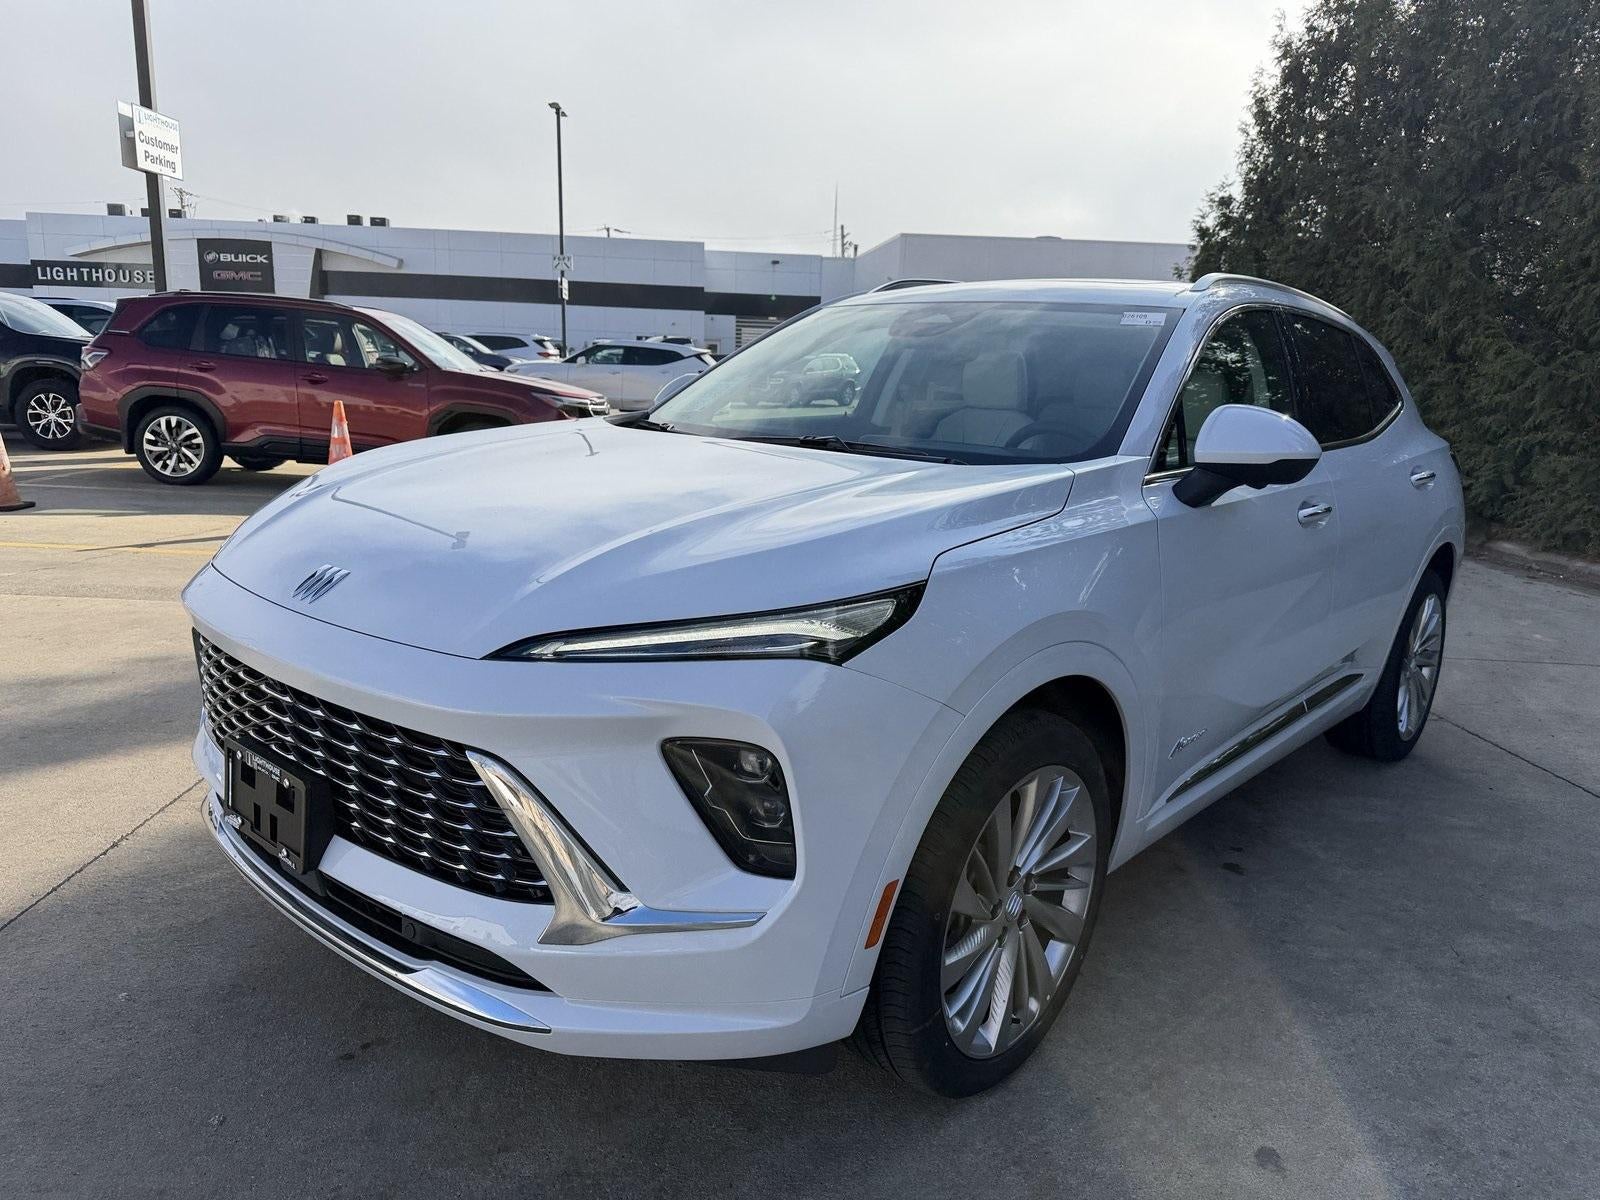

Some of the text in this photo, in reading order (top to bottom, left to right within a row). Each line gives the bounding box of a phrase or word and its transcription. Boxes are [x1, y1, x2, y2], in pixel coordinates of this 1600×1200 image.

[138, 130, 179, 154] Customer
[144, 150, 176, 173] Parking
[219, 253, 269, 263] BUICK
[37, 266, 155, 283] LIGHTHOUSE
[212, 270, 262, 281] GMC
